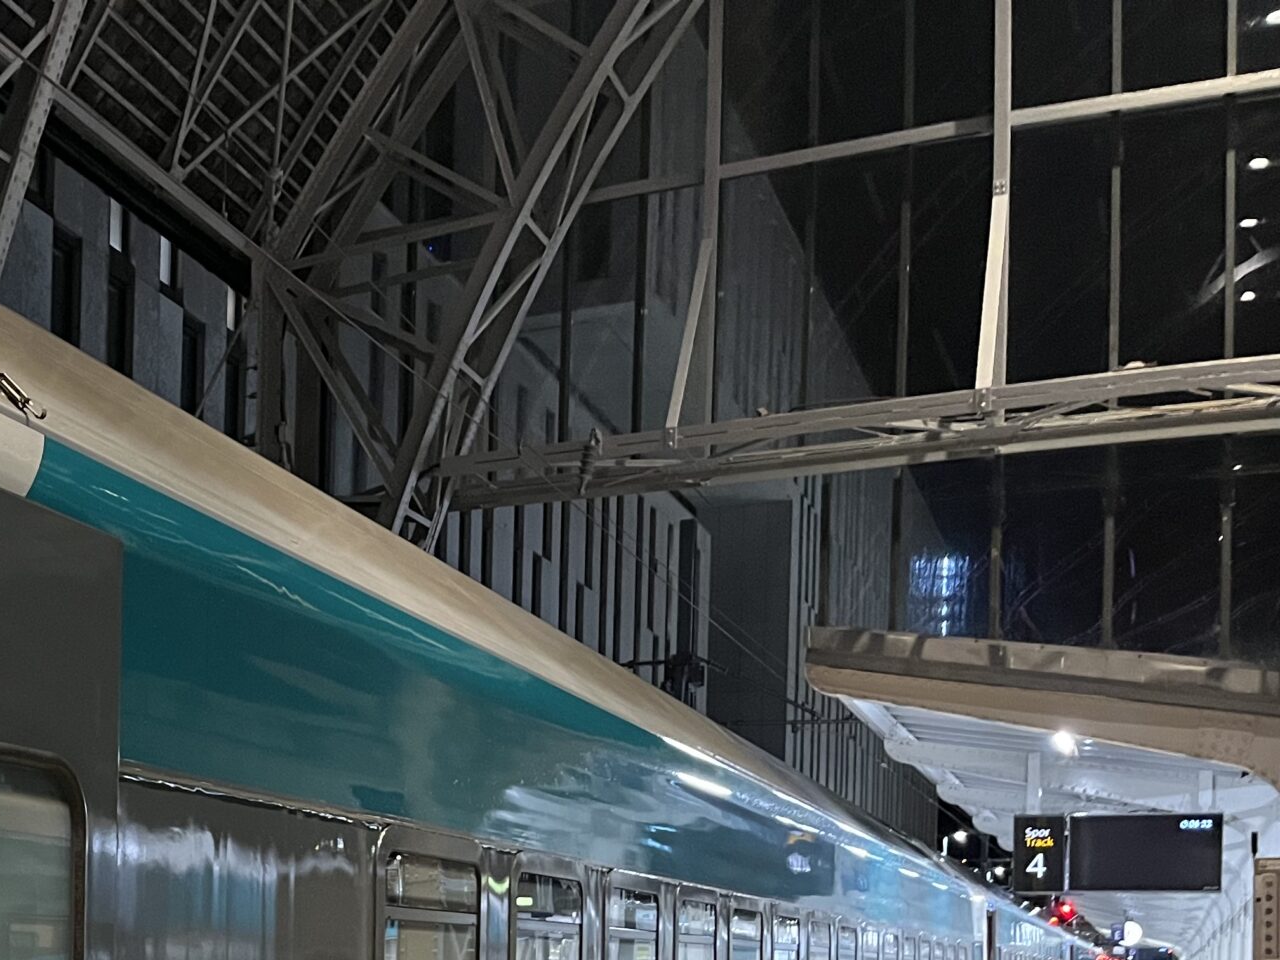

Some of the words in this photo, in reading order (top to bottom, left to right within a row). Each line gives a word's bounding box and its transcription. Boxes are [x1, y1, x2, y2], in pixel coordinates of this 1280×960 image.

[1024, 826, 1051, 839] Spor
[1024, 836, 1054, 848] Track
[1025, 852, 1047, 879] 4
